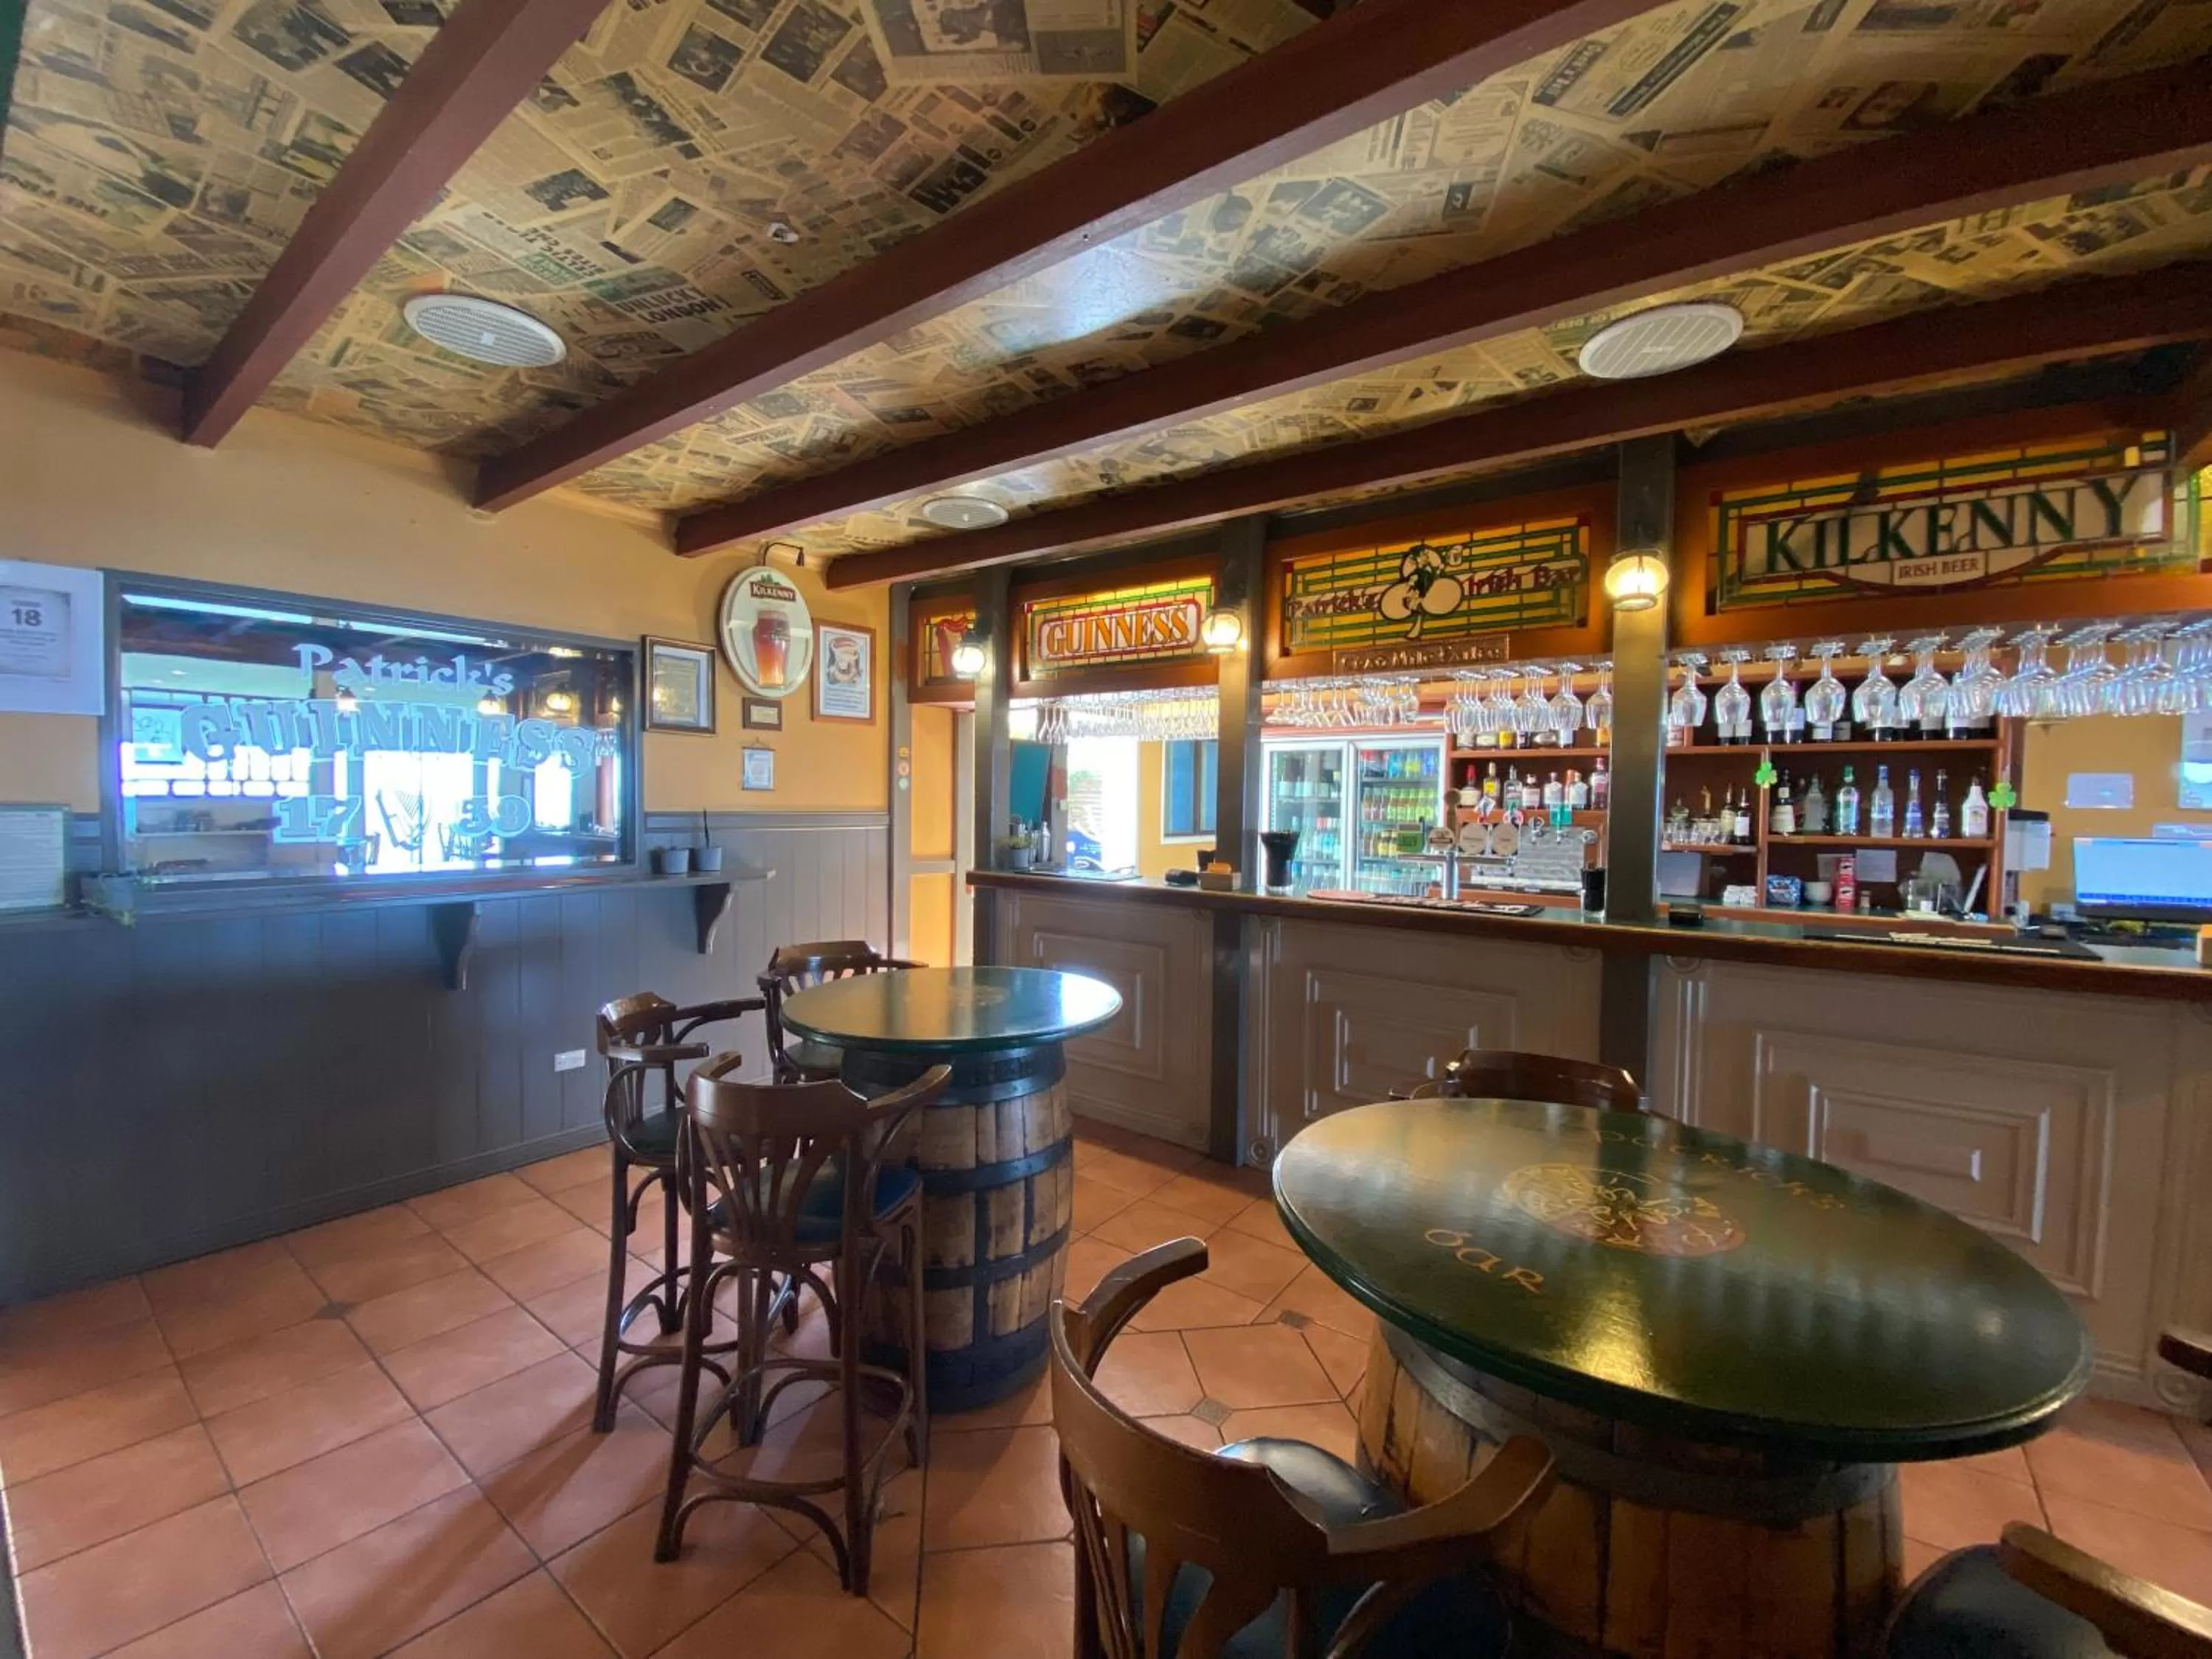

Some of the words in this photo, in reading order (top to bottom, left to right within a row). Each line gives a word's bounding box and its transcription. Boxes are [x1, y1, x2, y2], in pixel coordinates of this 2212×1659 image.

[1766, 476, 2139, 576] KILKENNY
[1899, 562, 1937, 579] IRISH
[1941, 558, 1979, 574] BEER
[12, 608, 43, 627] 18
[1046, 608, 1189, 655] GUINNESS
[293, 643, 515, 697] Patrick's
[182, 703, 595, 777] GUINNESS
[273, 795, 362, 843] 17
